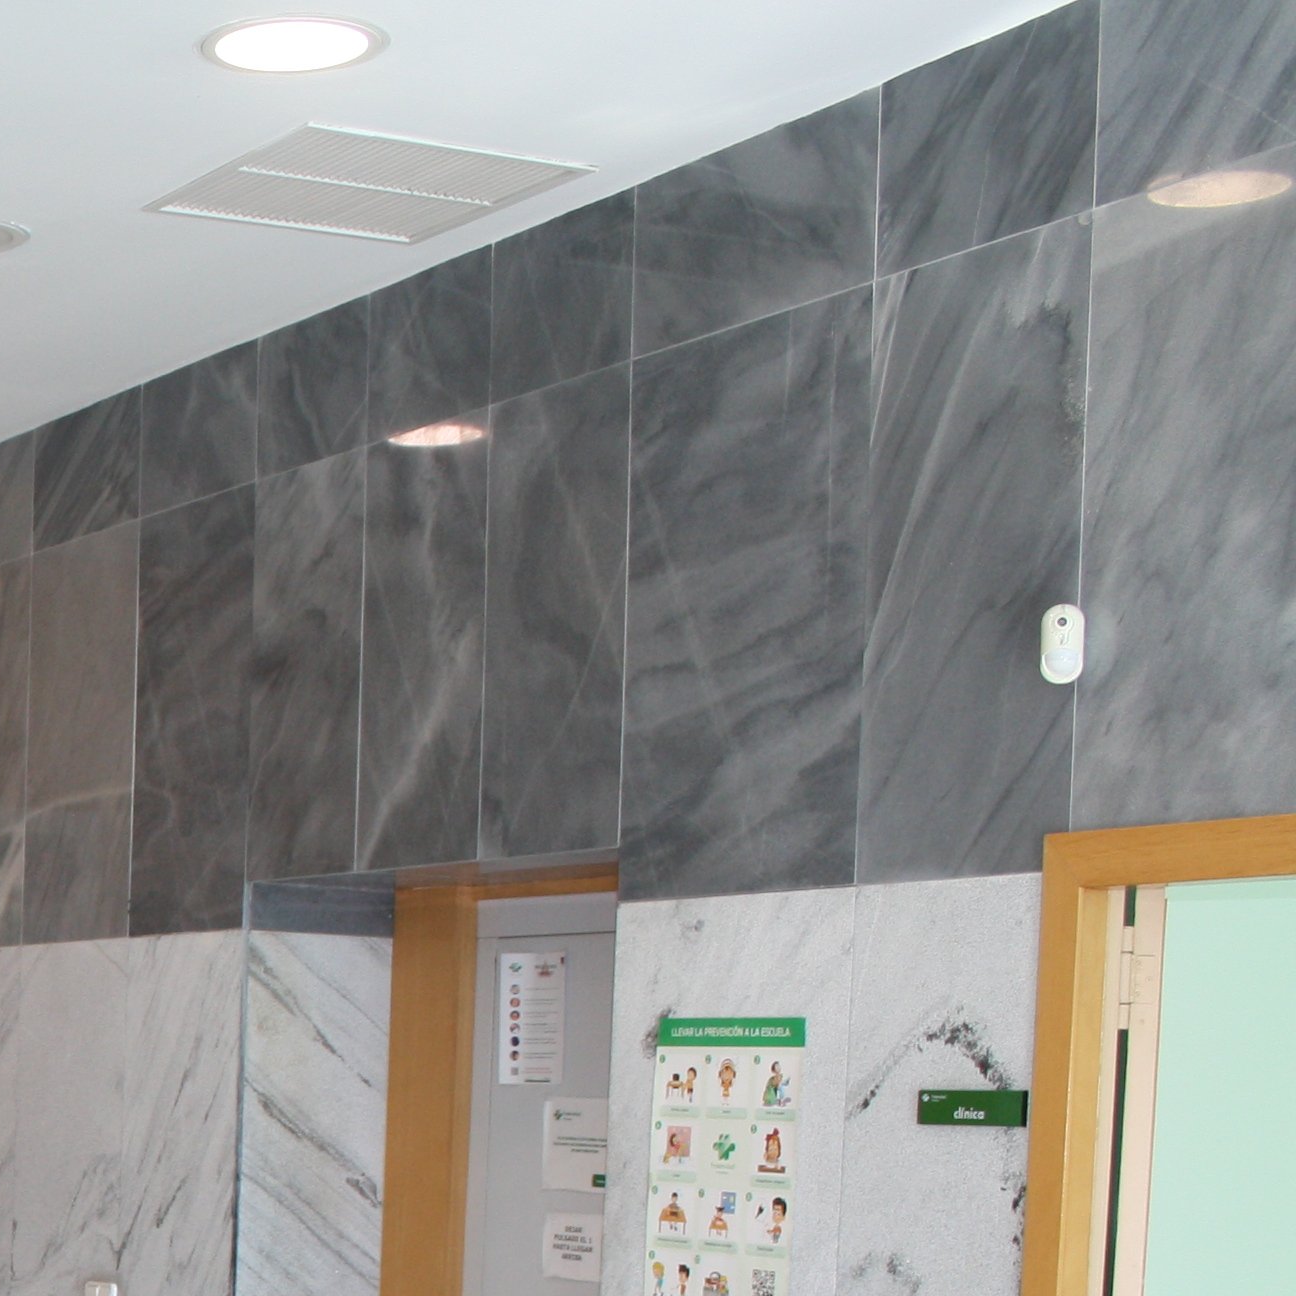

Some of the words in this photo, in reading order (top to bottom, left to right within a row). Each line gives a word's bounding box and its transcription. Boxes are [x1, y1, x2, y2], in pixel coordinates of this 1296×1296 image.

[671, 1026, 694, 1037] LLEVAR
[694, 1027, 704, 1037] LA
[704, 1025, 743, 1037] PREVENCIÓN
[743, 1027, 750, 1036] A
[751, 1027, 760, 1037] LA
[761, 1027, 791, 1037] ESCUELA
[953, 1106, 985, 1120] clínica
